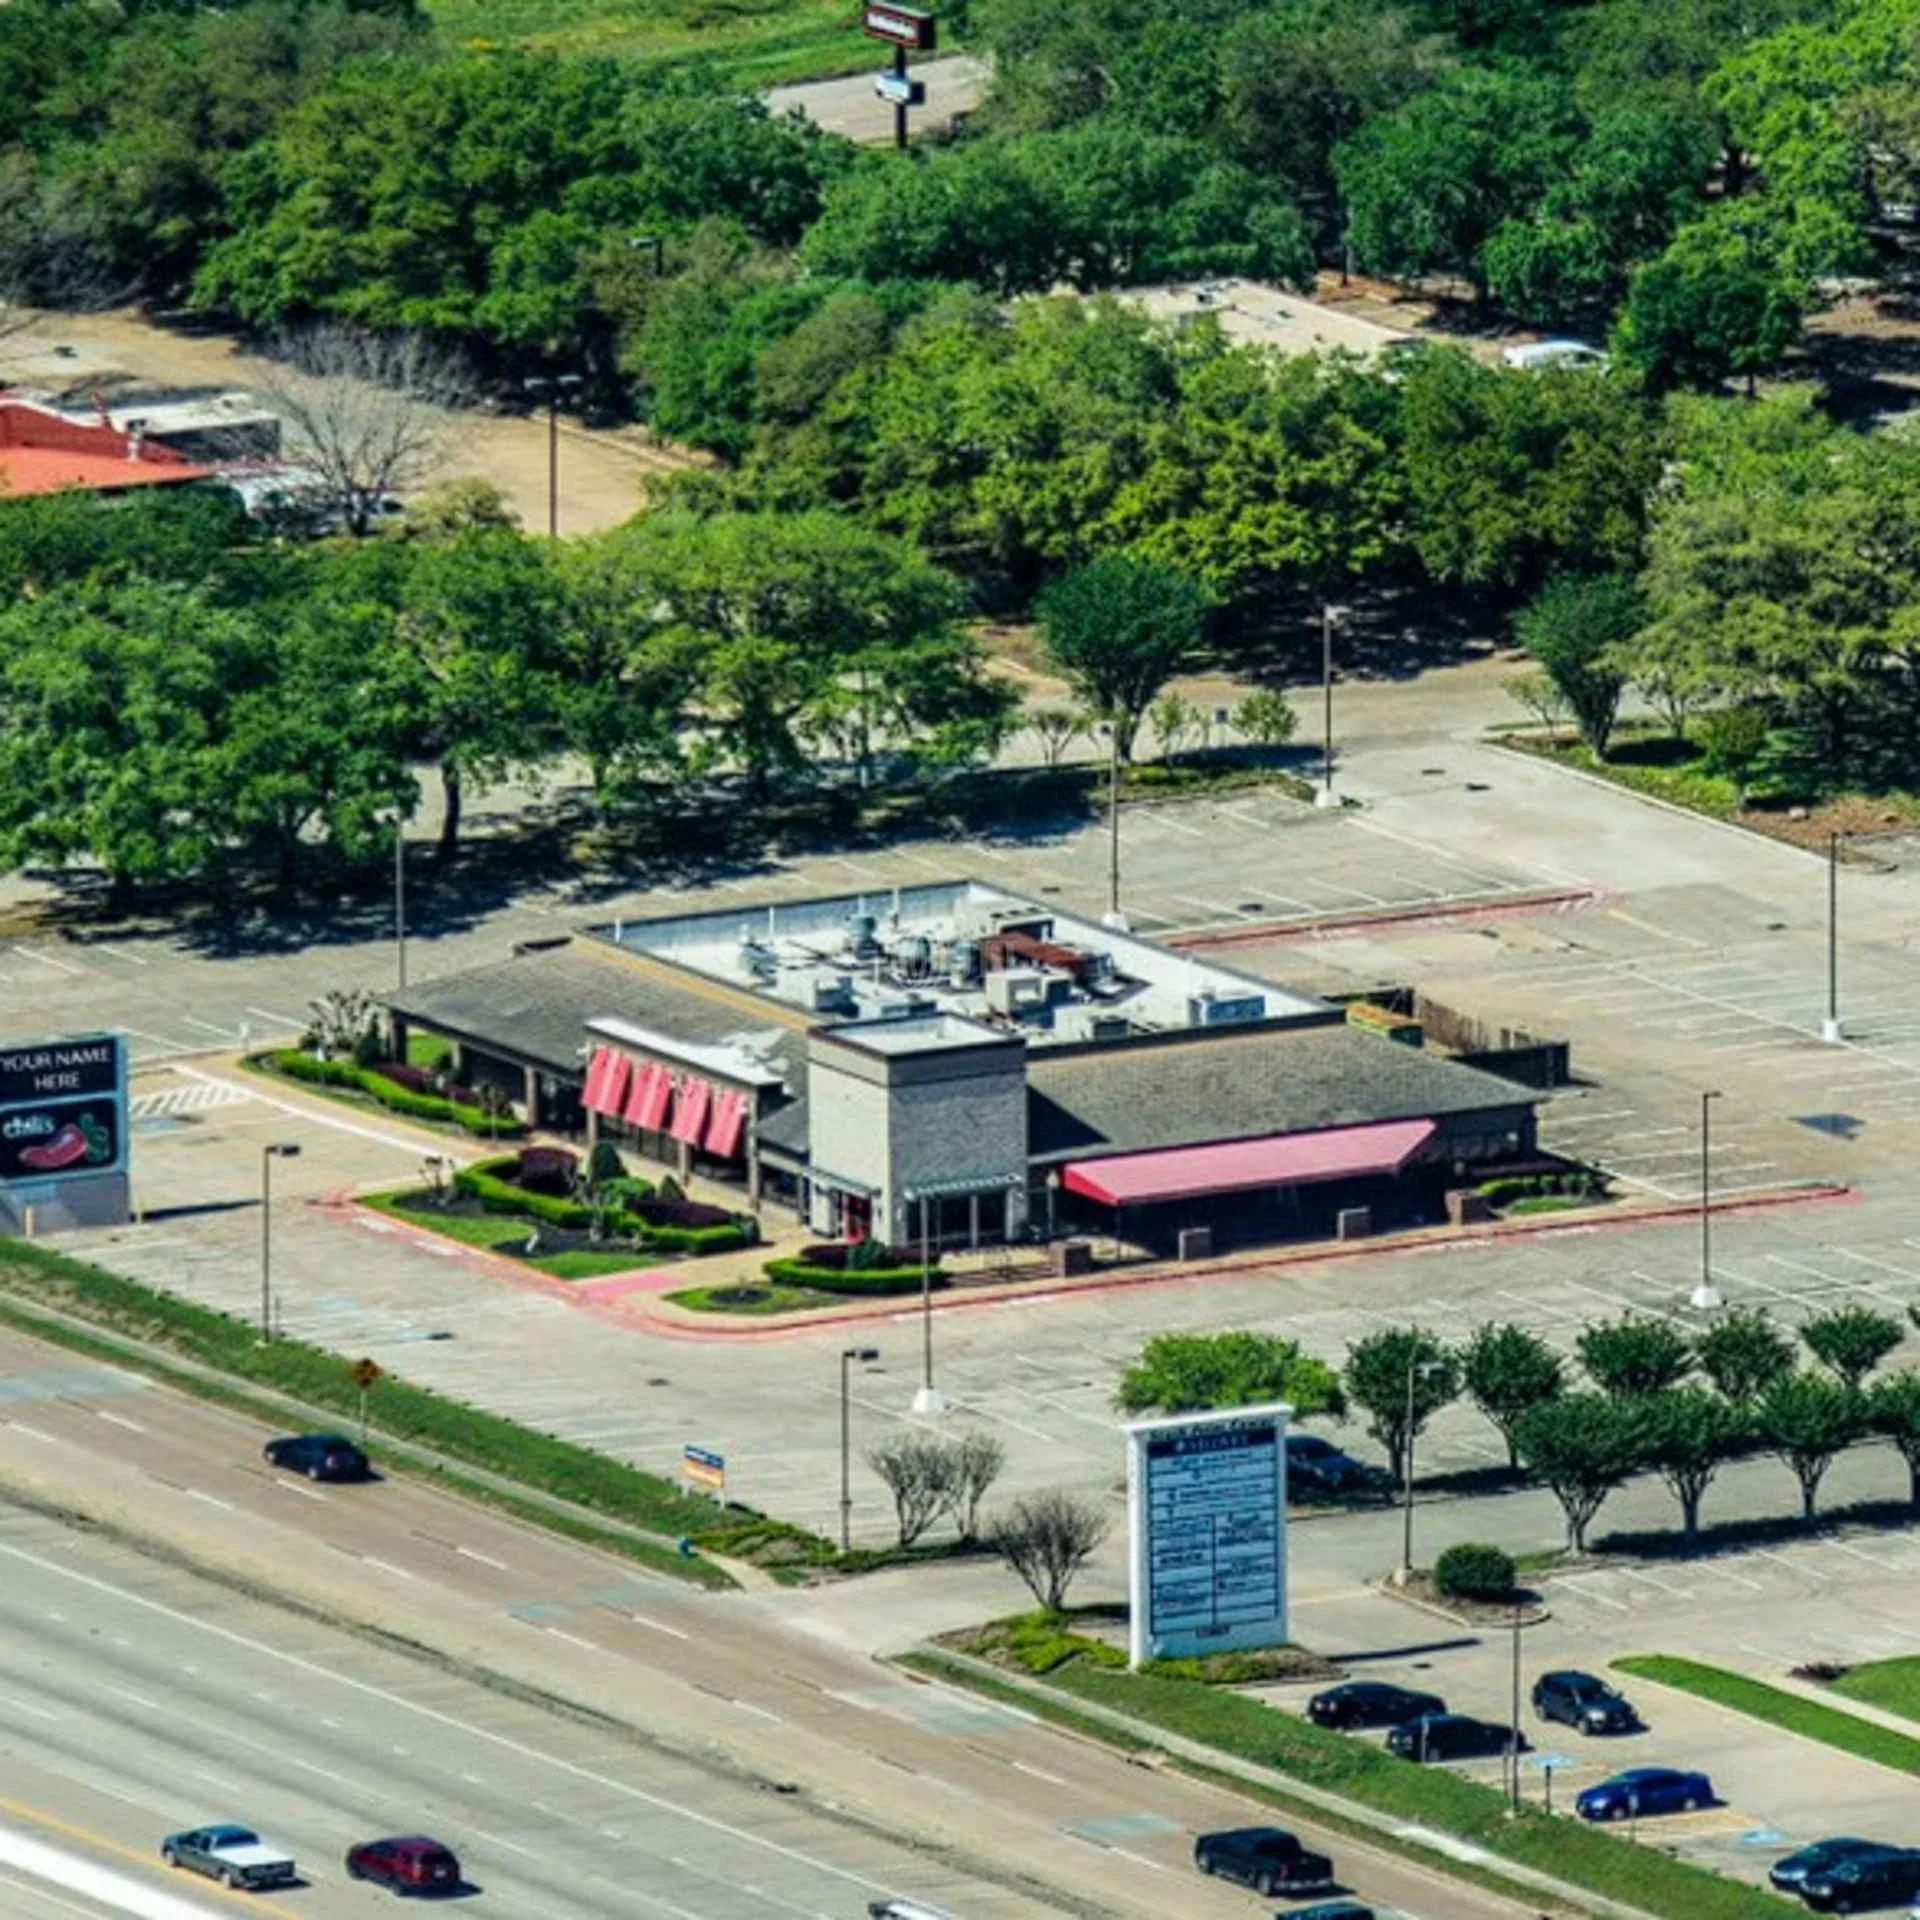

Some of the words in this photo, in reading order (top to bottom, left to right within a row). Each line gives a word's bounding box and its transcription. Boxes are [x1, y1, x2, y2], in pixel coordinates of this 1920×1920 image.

[1, 1052, 52, 1072] YOUR
[55, 1046, 110, 1067] NAME
[33, 1071, 80, 1092] HERE
